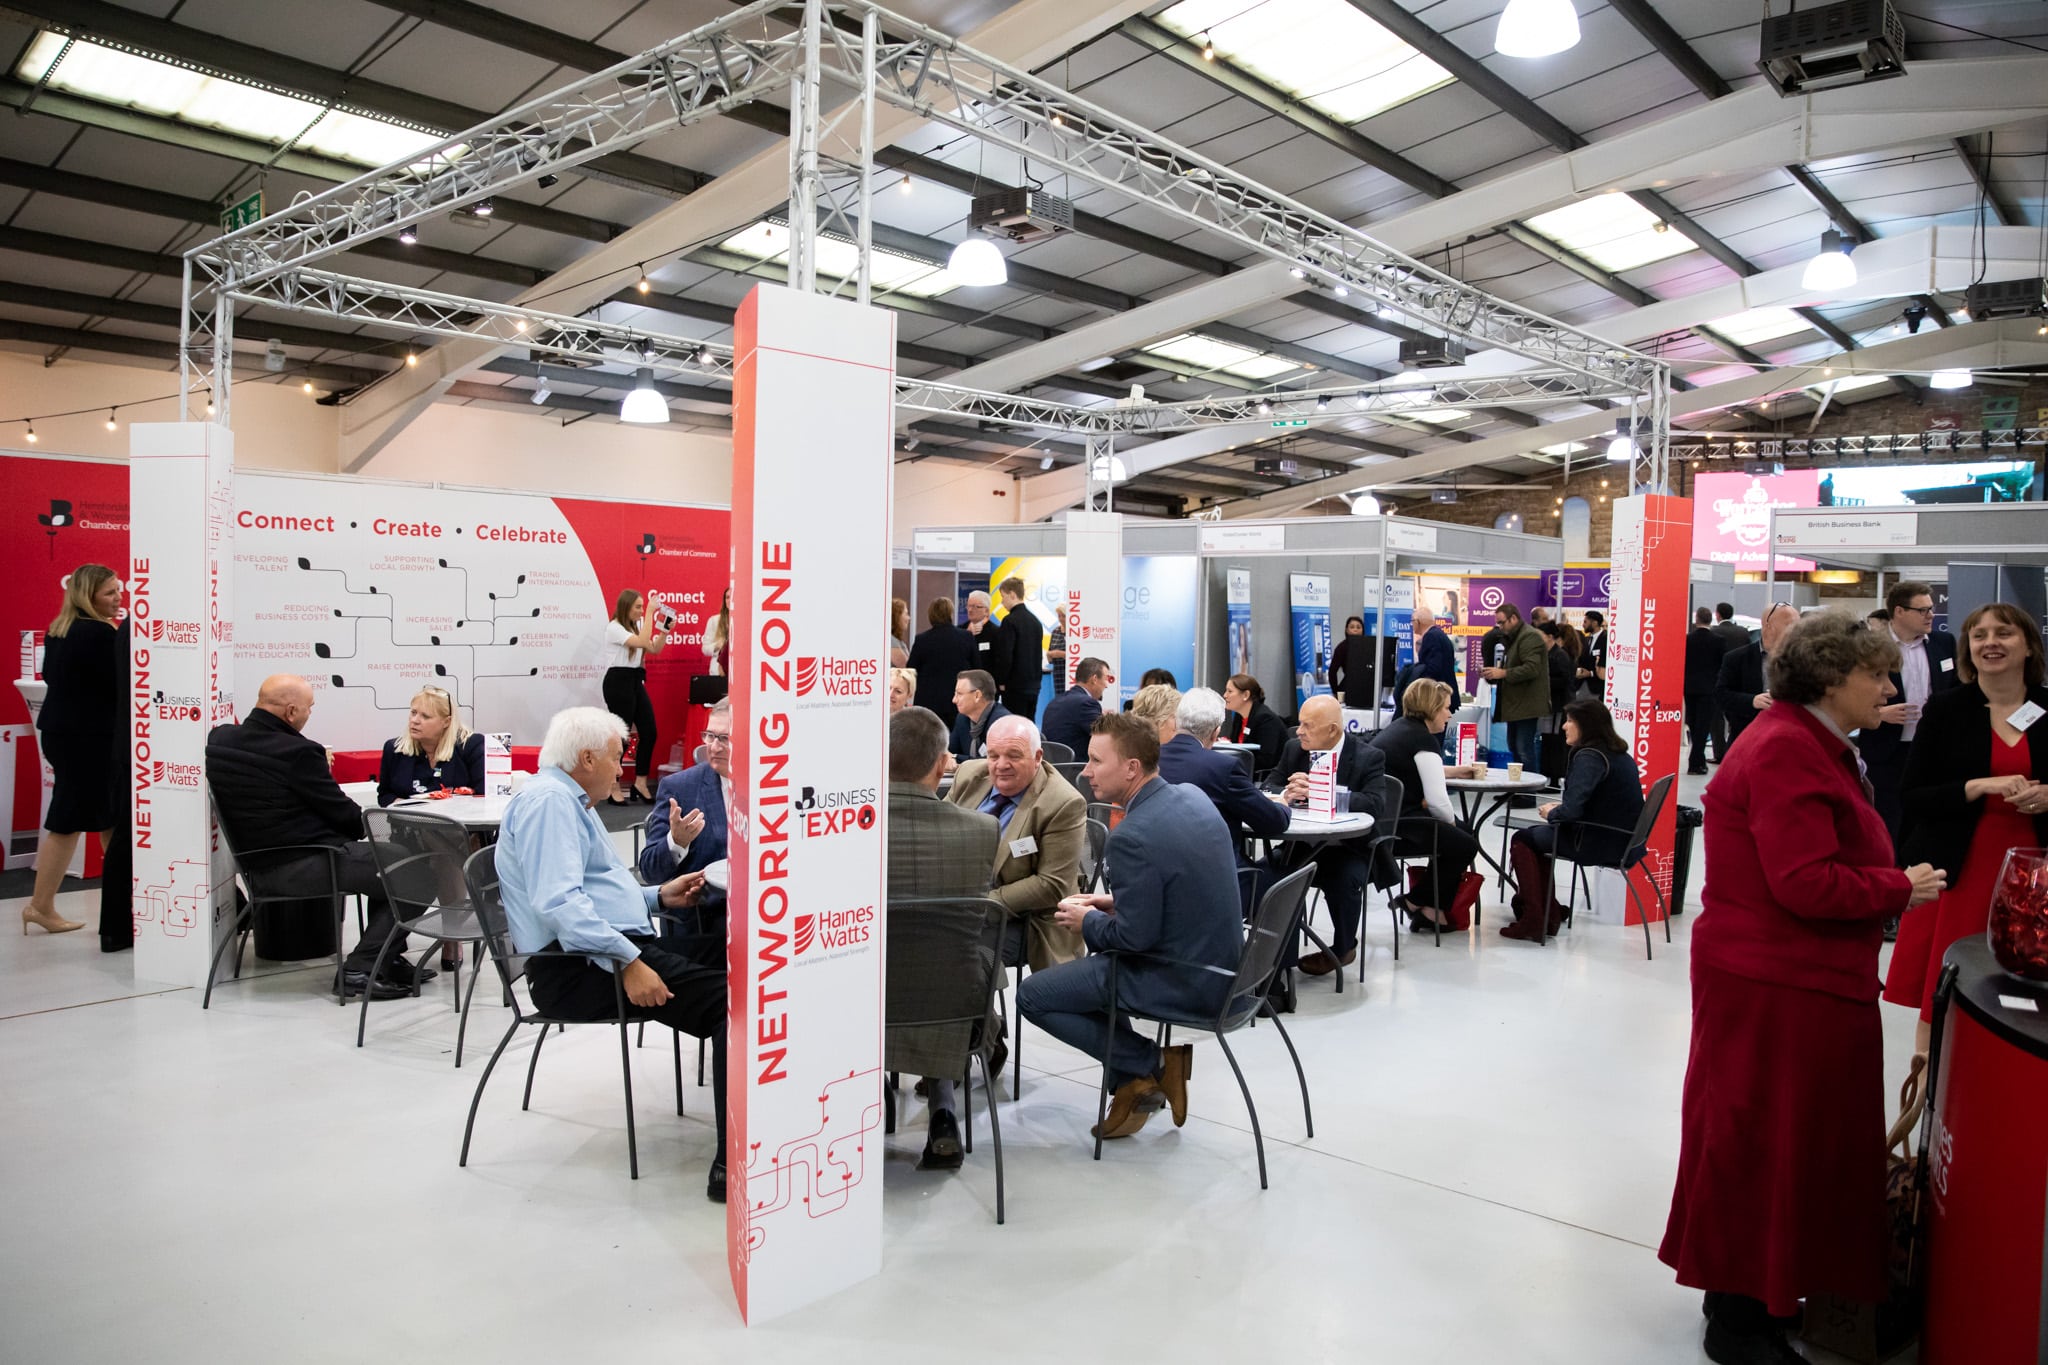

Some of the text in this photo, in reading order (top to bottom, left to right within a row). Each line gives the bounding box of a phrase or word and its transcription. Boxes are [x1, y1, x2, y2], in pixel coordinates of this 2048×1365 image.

[79, 519, 121, 530] Chamber
[237, 510, 568, 544] Connect Create Celebrate
[1807, 520, 1882, 529] British Business Bank
[384, 555, 435, 564] SUPPORTING
[1710, 551, 1741, 563] Digital
[255, 564, 289, 572] TALENT
[369, 562, 436, 572] LOCAL GROWTH
[529, 571, 560, 579] TRADING
[528, 579, 591, 587] INTERNATIONALLY
[647, 589, 706, 604] Connect
[284, 604, 329, 612] REDUCING
[1068, 590, 1081, 638] ZONE
[255, 613, 299, 621] BUSINESS
[406, 616, 453, 624] INCREASING
[166, 620, 201, 633] Haines
[429, 624, 454, 632] SALES
[1092, 625, 1116, 634] Haines
[1608, 598, 1618, 659] ZONE
[1641, 597, 1656, 661] ZONE
[167, 631, 198, 644] Watts
[1093, 632, 1114, 641] Watts
[394, 663, 433, 671] COMPANY
[542, 665, 578, 673] EMPLOYEE
[821, 656, 877, 676] Haines
[400, 670, 433, 678] PROFILE
[822, 676, 873, 697] Watts
[133, 557, 152, 849] NETWORKING ZONE
[153, 690, 202, 706] BUSINESS
[159, 705, 202, 722] EXPO
[1615, 709, 1634, 722] EXPO
[1655, 710, 1682, 723] EXPO
[166, 761, 202, 775] Haines
[167, 774, 199, 787] Watts
[795, 786, 876, 811] BUSINESS
[757, 541, 792, 1085] NETWORKING ZONE
[807, 804, 876, 838] EXPO
[819, 905, 874, 931] Haines
[820, 925, 870, 950] Watts
